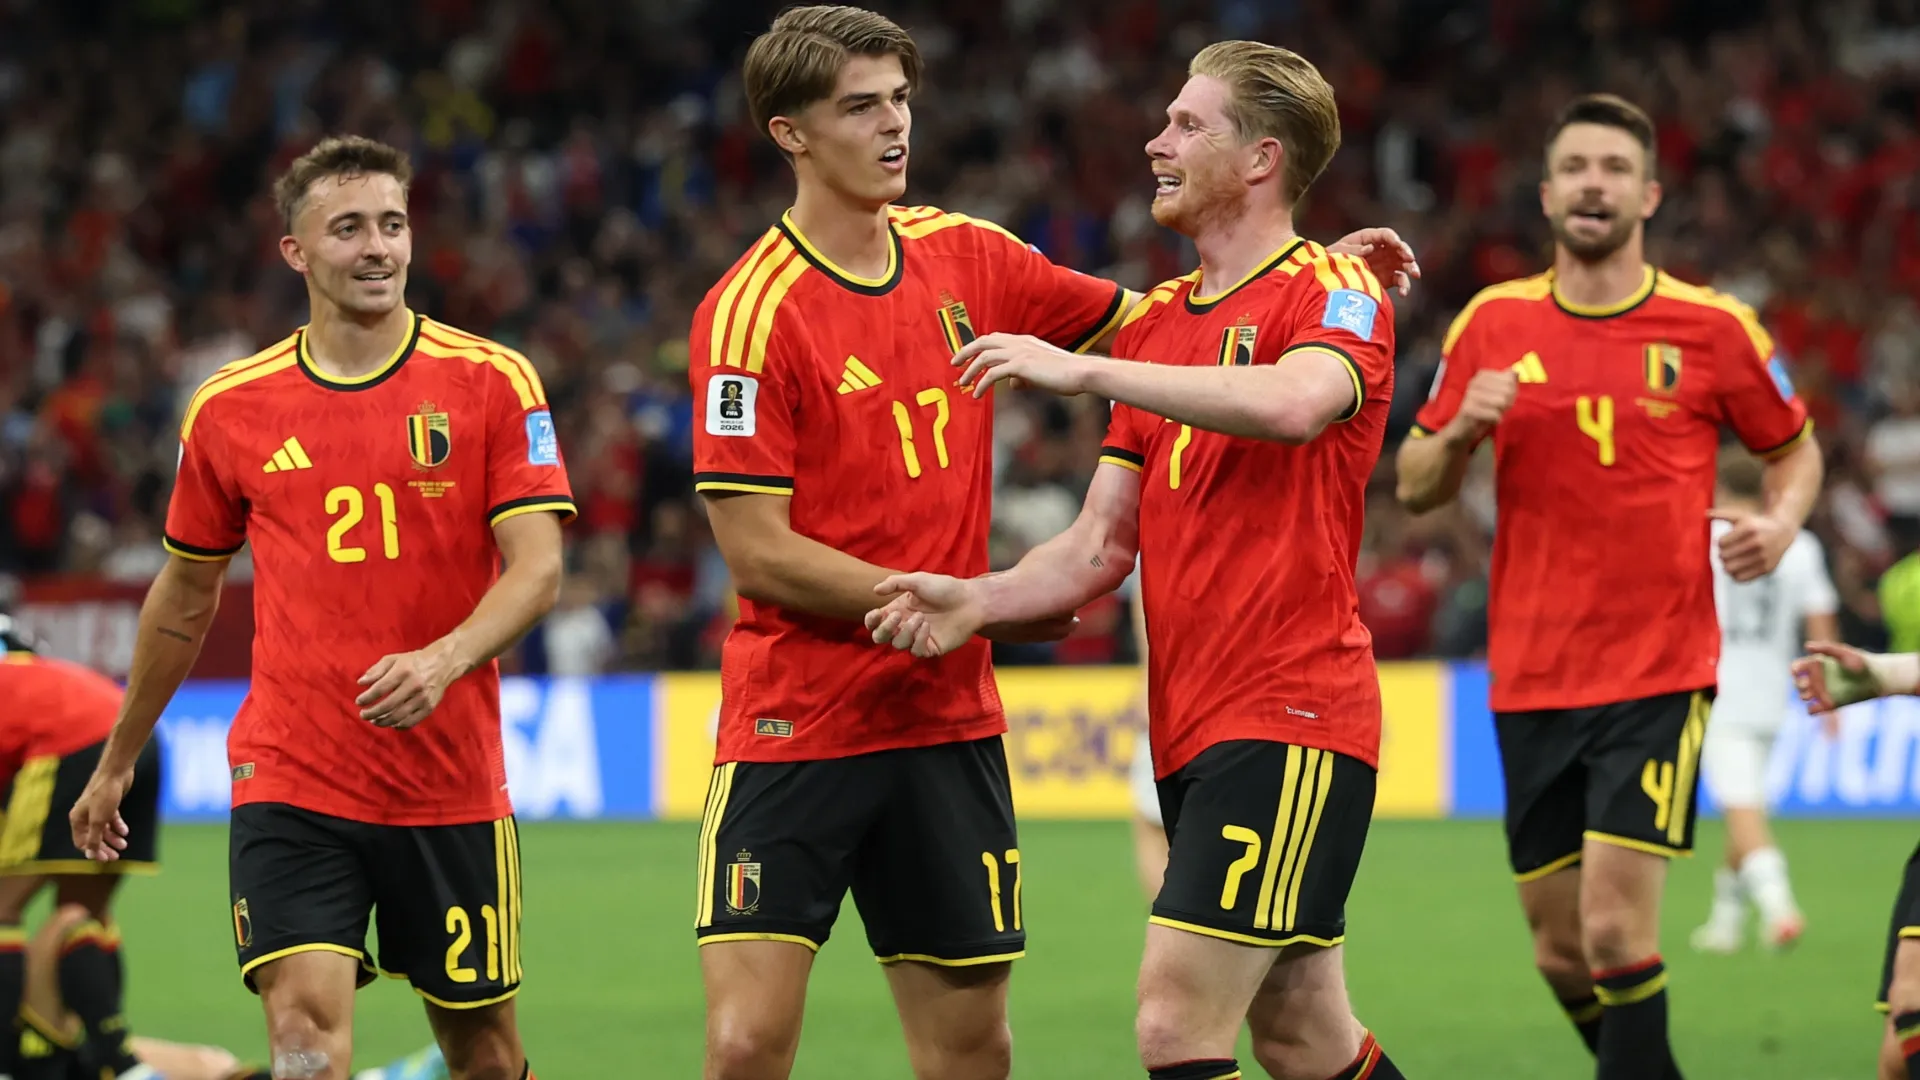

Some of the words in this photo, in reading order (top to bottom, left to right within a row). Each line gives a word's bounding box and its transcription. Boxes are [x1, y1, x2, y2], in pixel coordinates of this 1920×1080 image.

[892, 387, 950, 479] 17
[1576, 394, 1616, 468] 4
[325, 482, 400, 563] 21
[1641, 758, 1674, 831] 4
[982, 848, 1021, 932] 17
[1220, 824, 1262, 910] 7
[445, 904, 499, 983] 21
